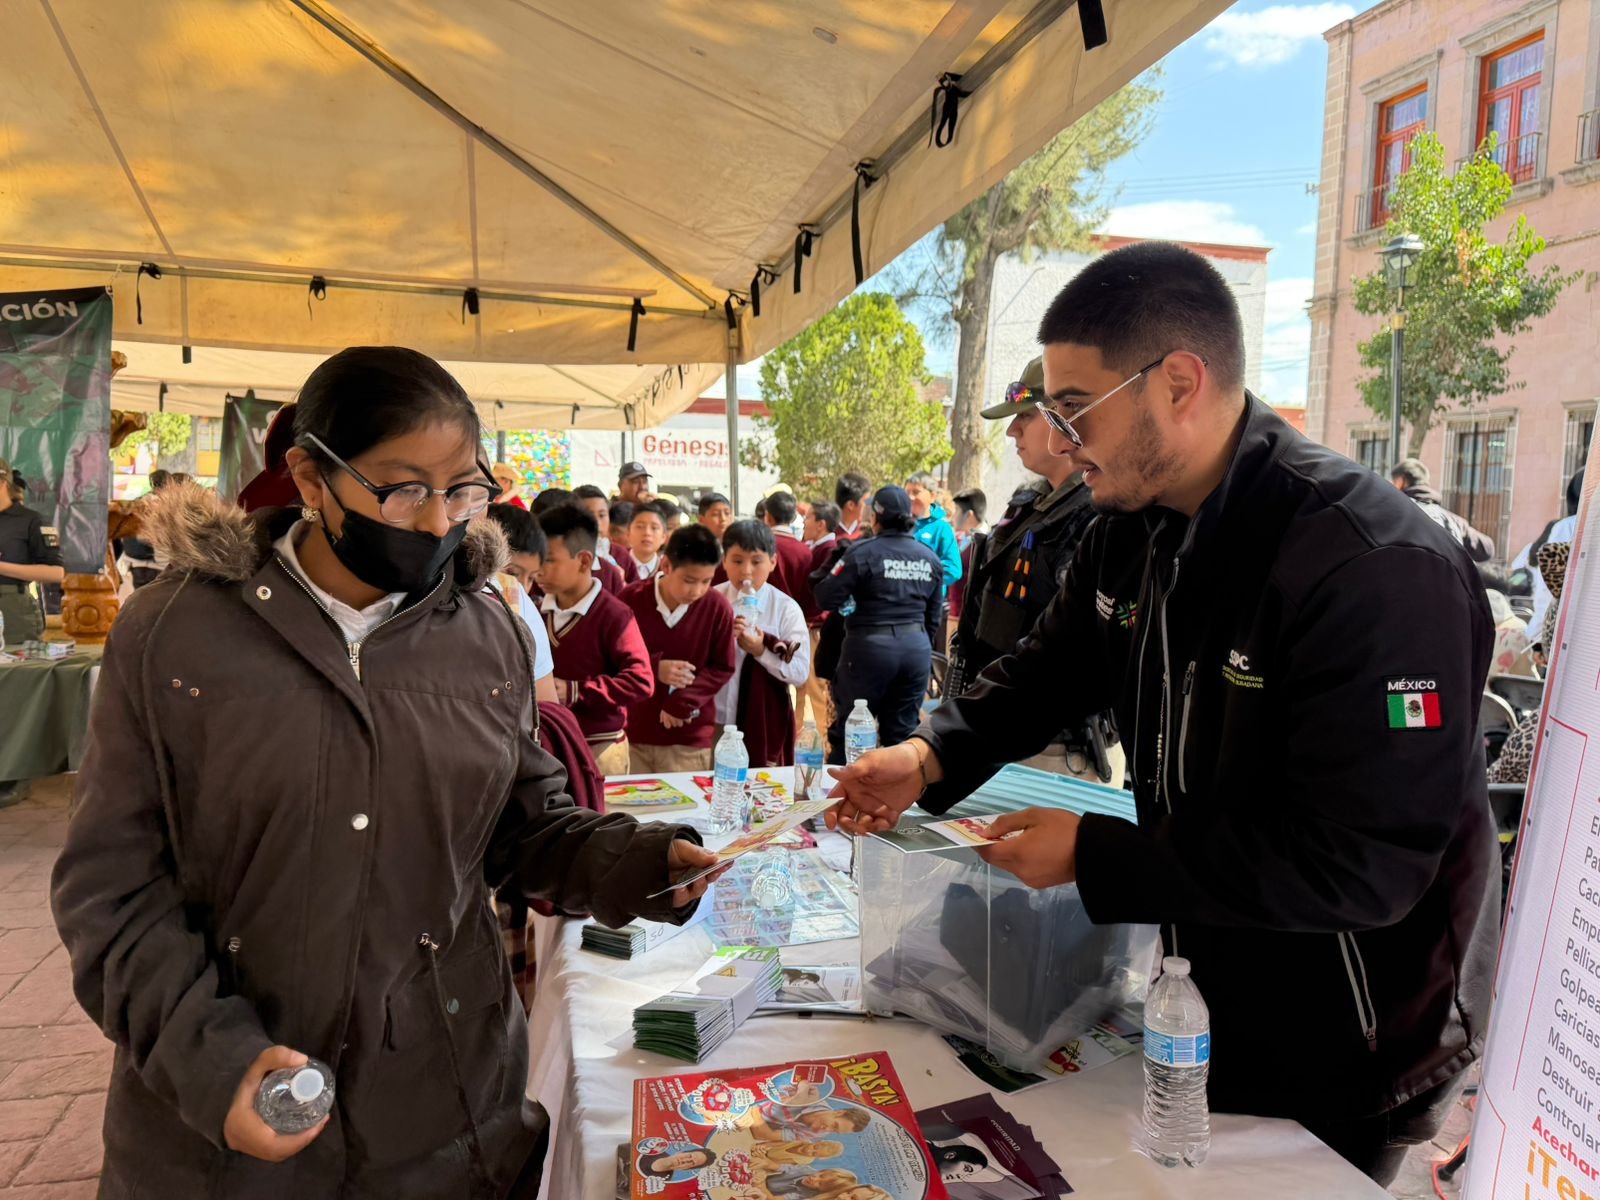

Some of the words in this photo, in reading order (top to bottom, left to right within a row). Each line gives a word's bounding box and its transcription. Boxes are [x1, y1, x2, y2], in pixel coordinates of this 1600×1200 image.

[0, 298, 78, 321] CIÓN
[883, 559, 932, 573] POLICÍA
[883, 569, 932, 582] MUNICIPAL
[1387, 678, 1437, 691] MÉXICO
[1584, 846, 1600, 873] Pa
[1579, 877, 1600, 908] Cac
[1554, 998, 1600, 1049] Caricias
[1542, 1055, 1594, 1114] Destruir
[1537, 1087, 1600, 1154] Controlar
[1531, 1115, 1600, 1182] Acechar
